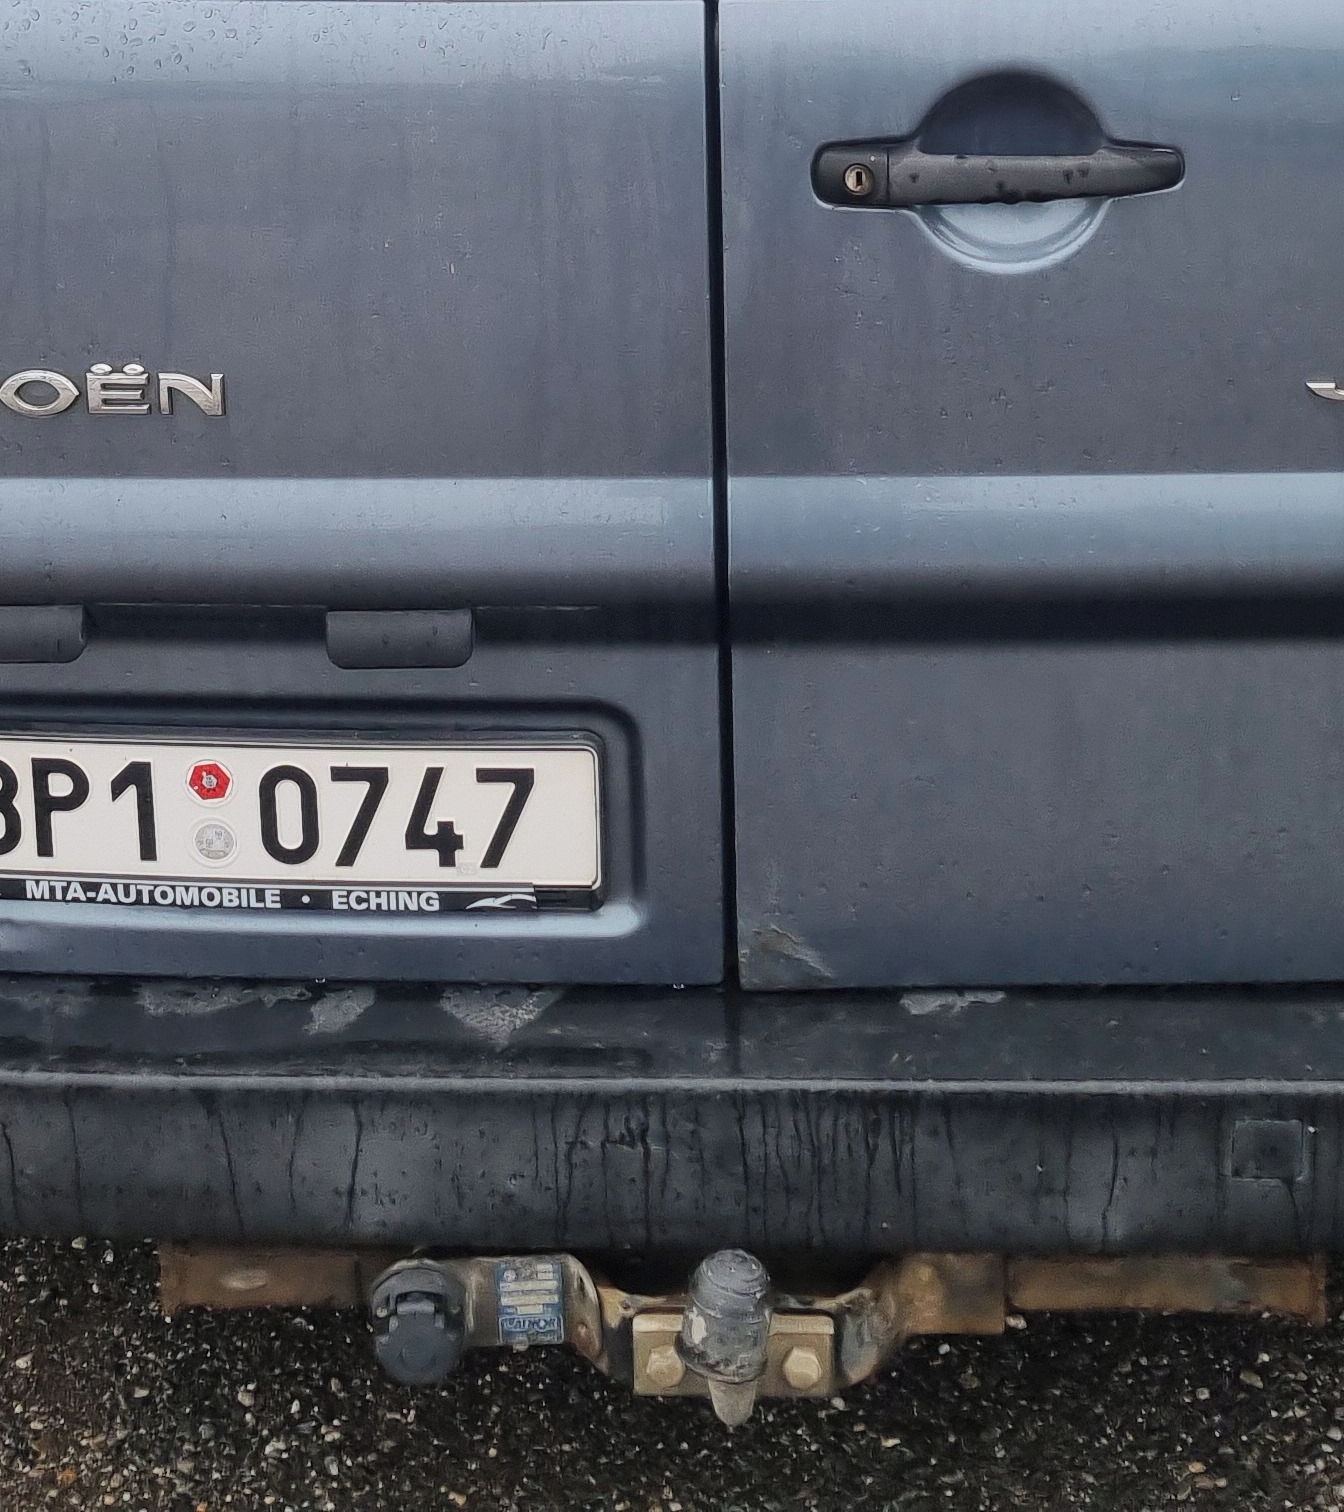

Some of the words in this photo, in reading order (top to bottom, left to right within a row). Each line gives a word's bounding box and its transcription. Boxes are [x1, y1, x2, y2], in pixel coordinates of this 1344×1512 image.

[258, 764, 535, 869] 0747
[25, 879, 282, 909] MTA-AUTOMOBILE
[332, 890, 440, 912] ECHING
